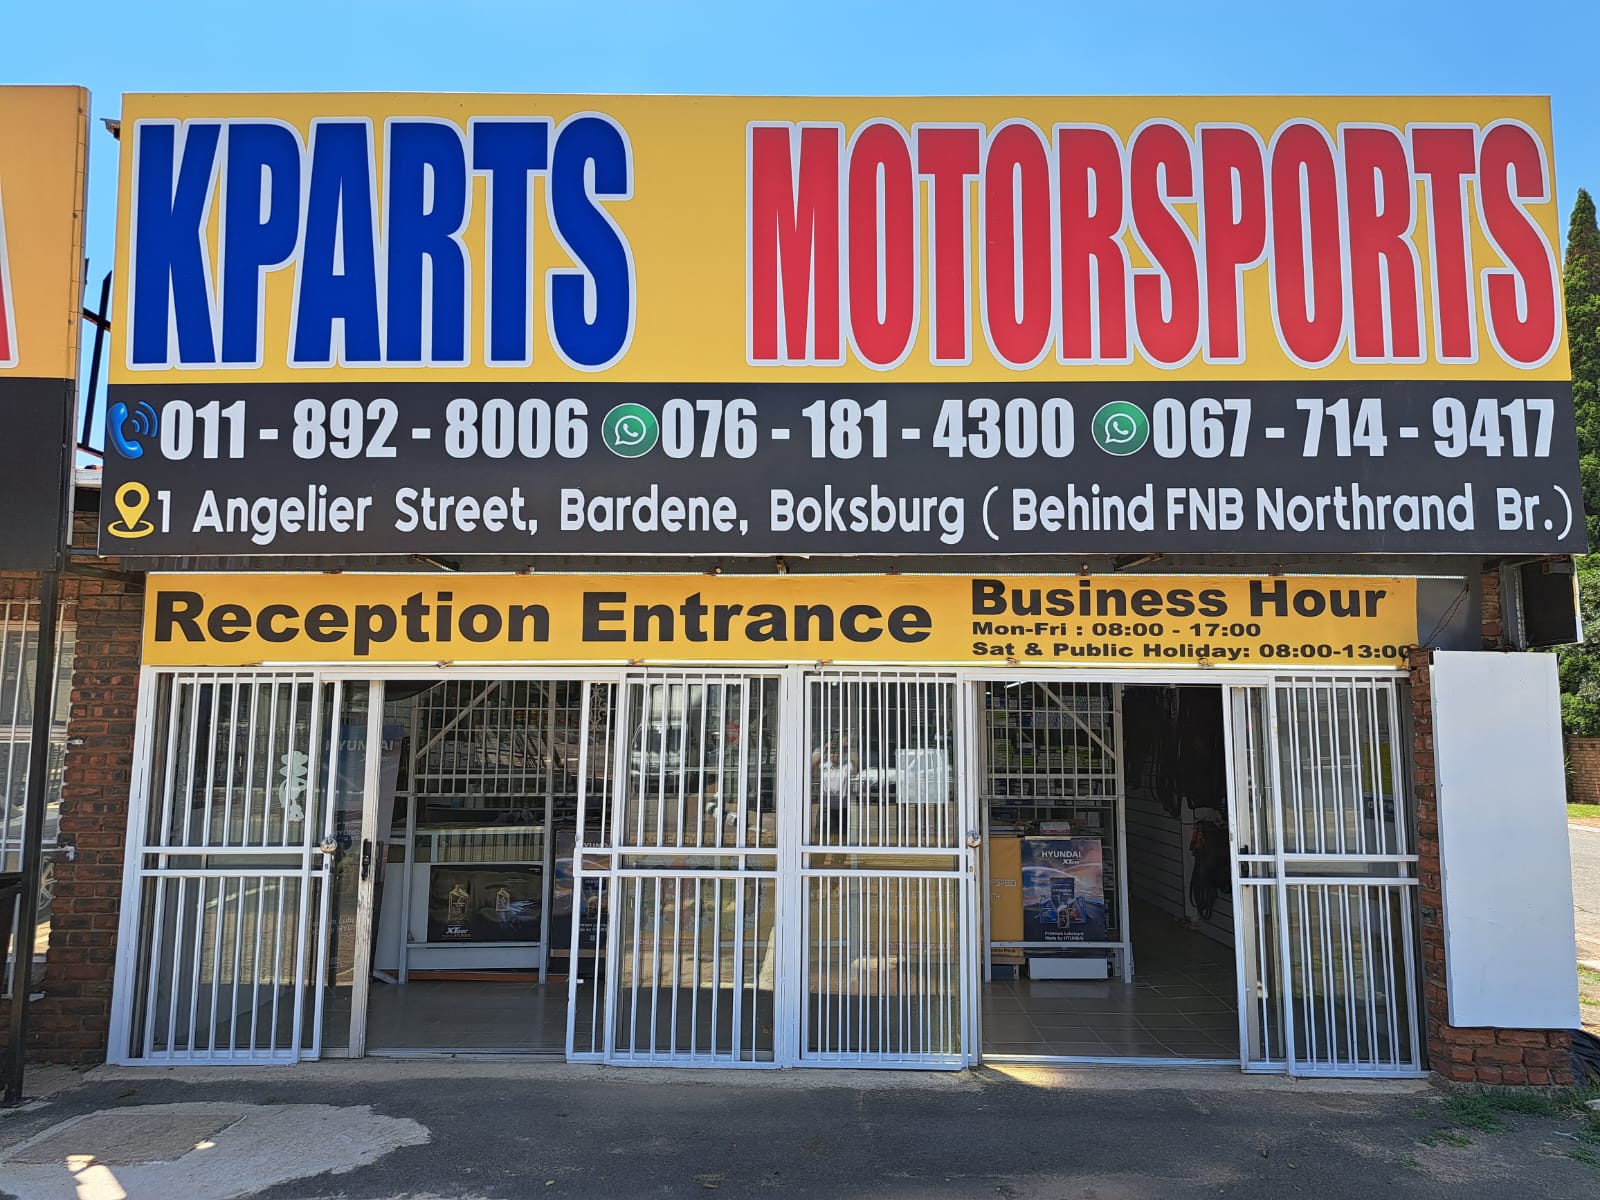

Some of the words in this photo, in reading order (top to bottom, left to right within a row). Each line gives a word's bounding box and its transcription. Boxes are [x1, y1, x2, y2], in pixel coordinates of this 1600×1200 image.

[127, 112, 635, 371] KPARTS
[745, 117, 1563, 371] MOTORSPORTS
[161, 400, 245, 460] 011
[260, 429, 278, 439] -
[293, 399, 398, 459] 892
[412, 428, 430, 439] -
[445, 399, 588, 458] 8006
[662, 398, 758, 458] 076
[772, 429, 789, 439] -
[802, 399, 887, 459] 181
[902, 429, 920, 439] -
[933, 398, 1074, 458] 4300
[1152, 397, 1252, 459] 067
[1266, 428, 1284, 438] -
[1297, 399, 1387, 456] 714
[1400, 427, 1418, 437] -
[1433, 398, 1554, 457] 9417
[157, 490, 171, 533] 1
[192, 485, 372, 545] Angelier
[395, 487, 537, 535] Street,
[561, 484, 748, 535] Bardene,
[771, 485, 964, 544] Boksburg
[1013, 484, 1154, 531] Behind
[1167, 488, 1243, 530] FNB
[1257, 483, 1474, 531] Northrand
[1497, 485, 1572, 540] Br.)
[155, 591, 549, 655] Reception
[581, 591, 932, 643] Entrance
[972, 579, 1227, 617] Business
[1249, 580, 1386, 617] Hour
[972, 622, 1067, 637] Mon-Fri
[1076, 625, 1083, 637] :
[1092, 623, 1164, 637] 08:00
[1189, 623, 1261, 638] 17:00
[972, 642, 1016, 656] Sat
[1024, 643, 1044, 657] &
[1053, 642, 1133, 659] Public
[1143, 642, 1251, 664] Holiday:
[1259, 644, 1409, 659] 08:00-13:00
[1041, 850, 1082, 859] HYUNDAI
